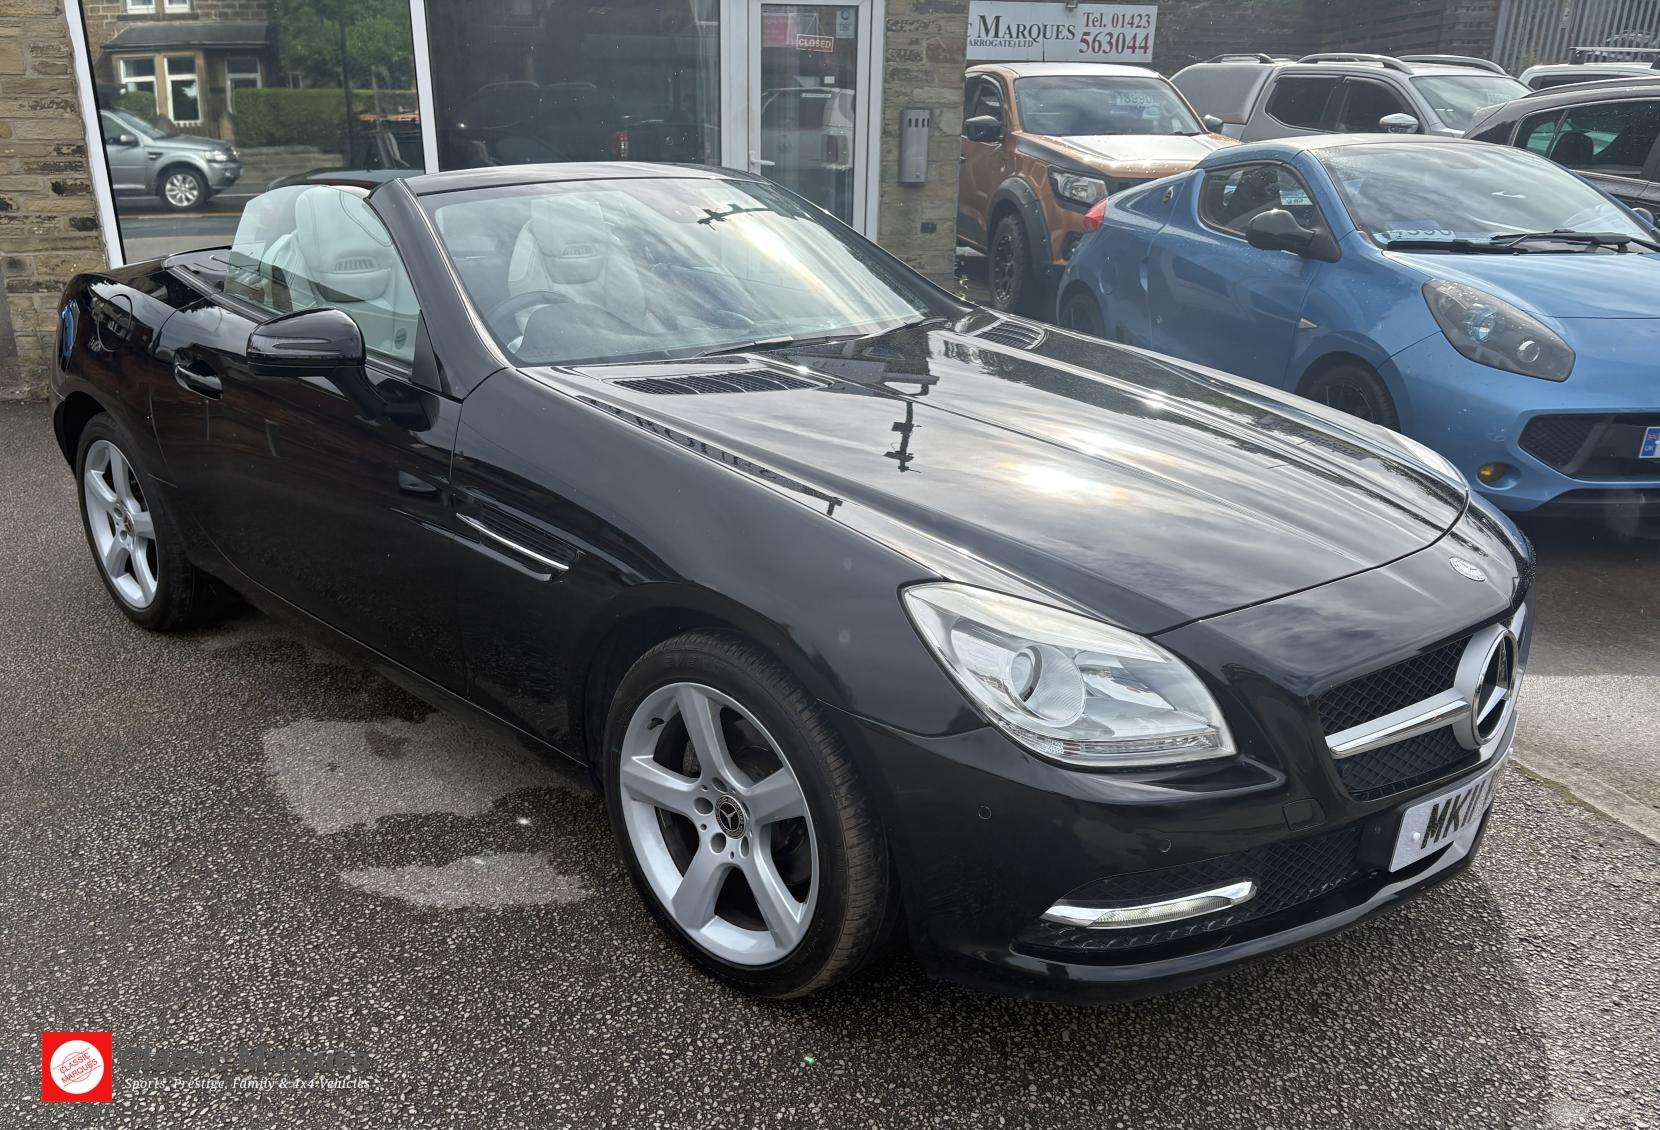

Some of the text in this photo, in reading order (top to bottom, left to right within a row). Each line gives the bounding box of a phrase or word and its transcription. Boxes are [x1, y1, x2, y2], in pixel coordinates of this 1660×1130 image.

[976, 14, 1076, 43] MARQUES
[1083, 12, 1151, 29] Tel. 01423
[799, 38, 832, 49] CLOSED
[1017, 40, 1034, 48] LTD
[1078, 31, 1150, 55] 563044
